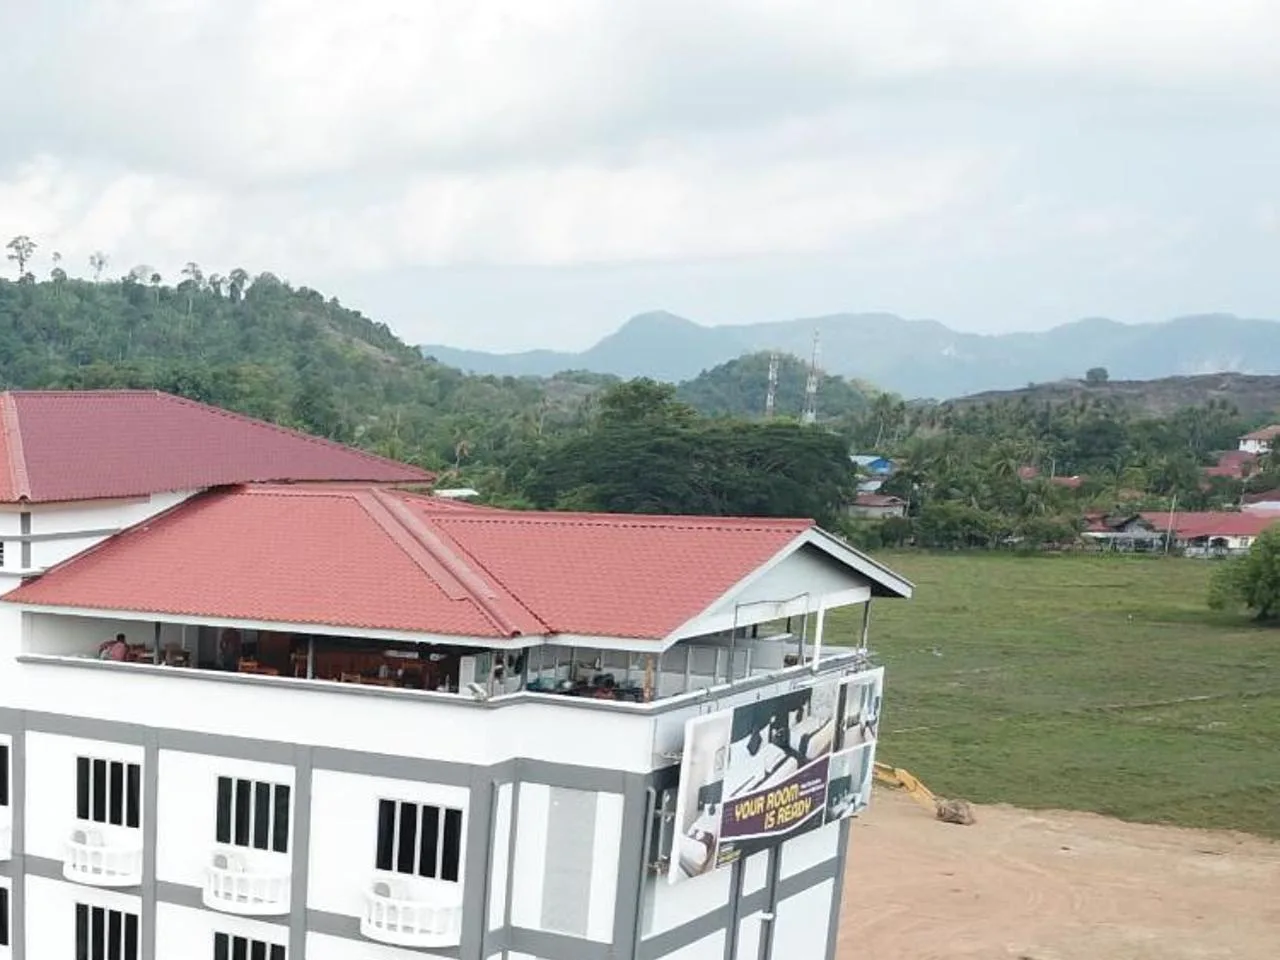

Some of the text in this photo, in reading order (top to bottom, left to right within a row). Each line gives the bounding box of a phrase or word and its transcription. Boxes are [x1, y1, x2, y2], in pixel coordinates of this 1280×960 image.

[735, 796, 765, 821] YOUR
[766, 783, 799, 810] ROOM
[764, 797, 812, 830] IS READY
